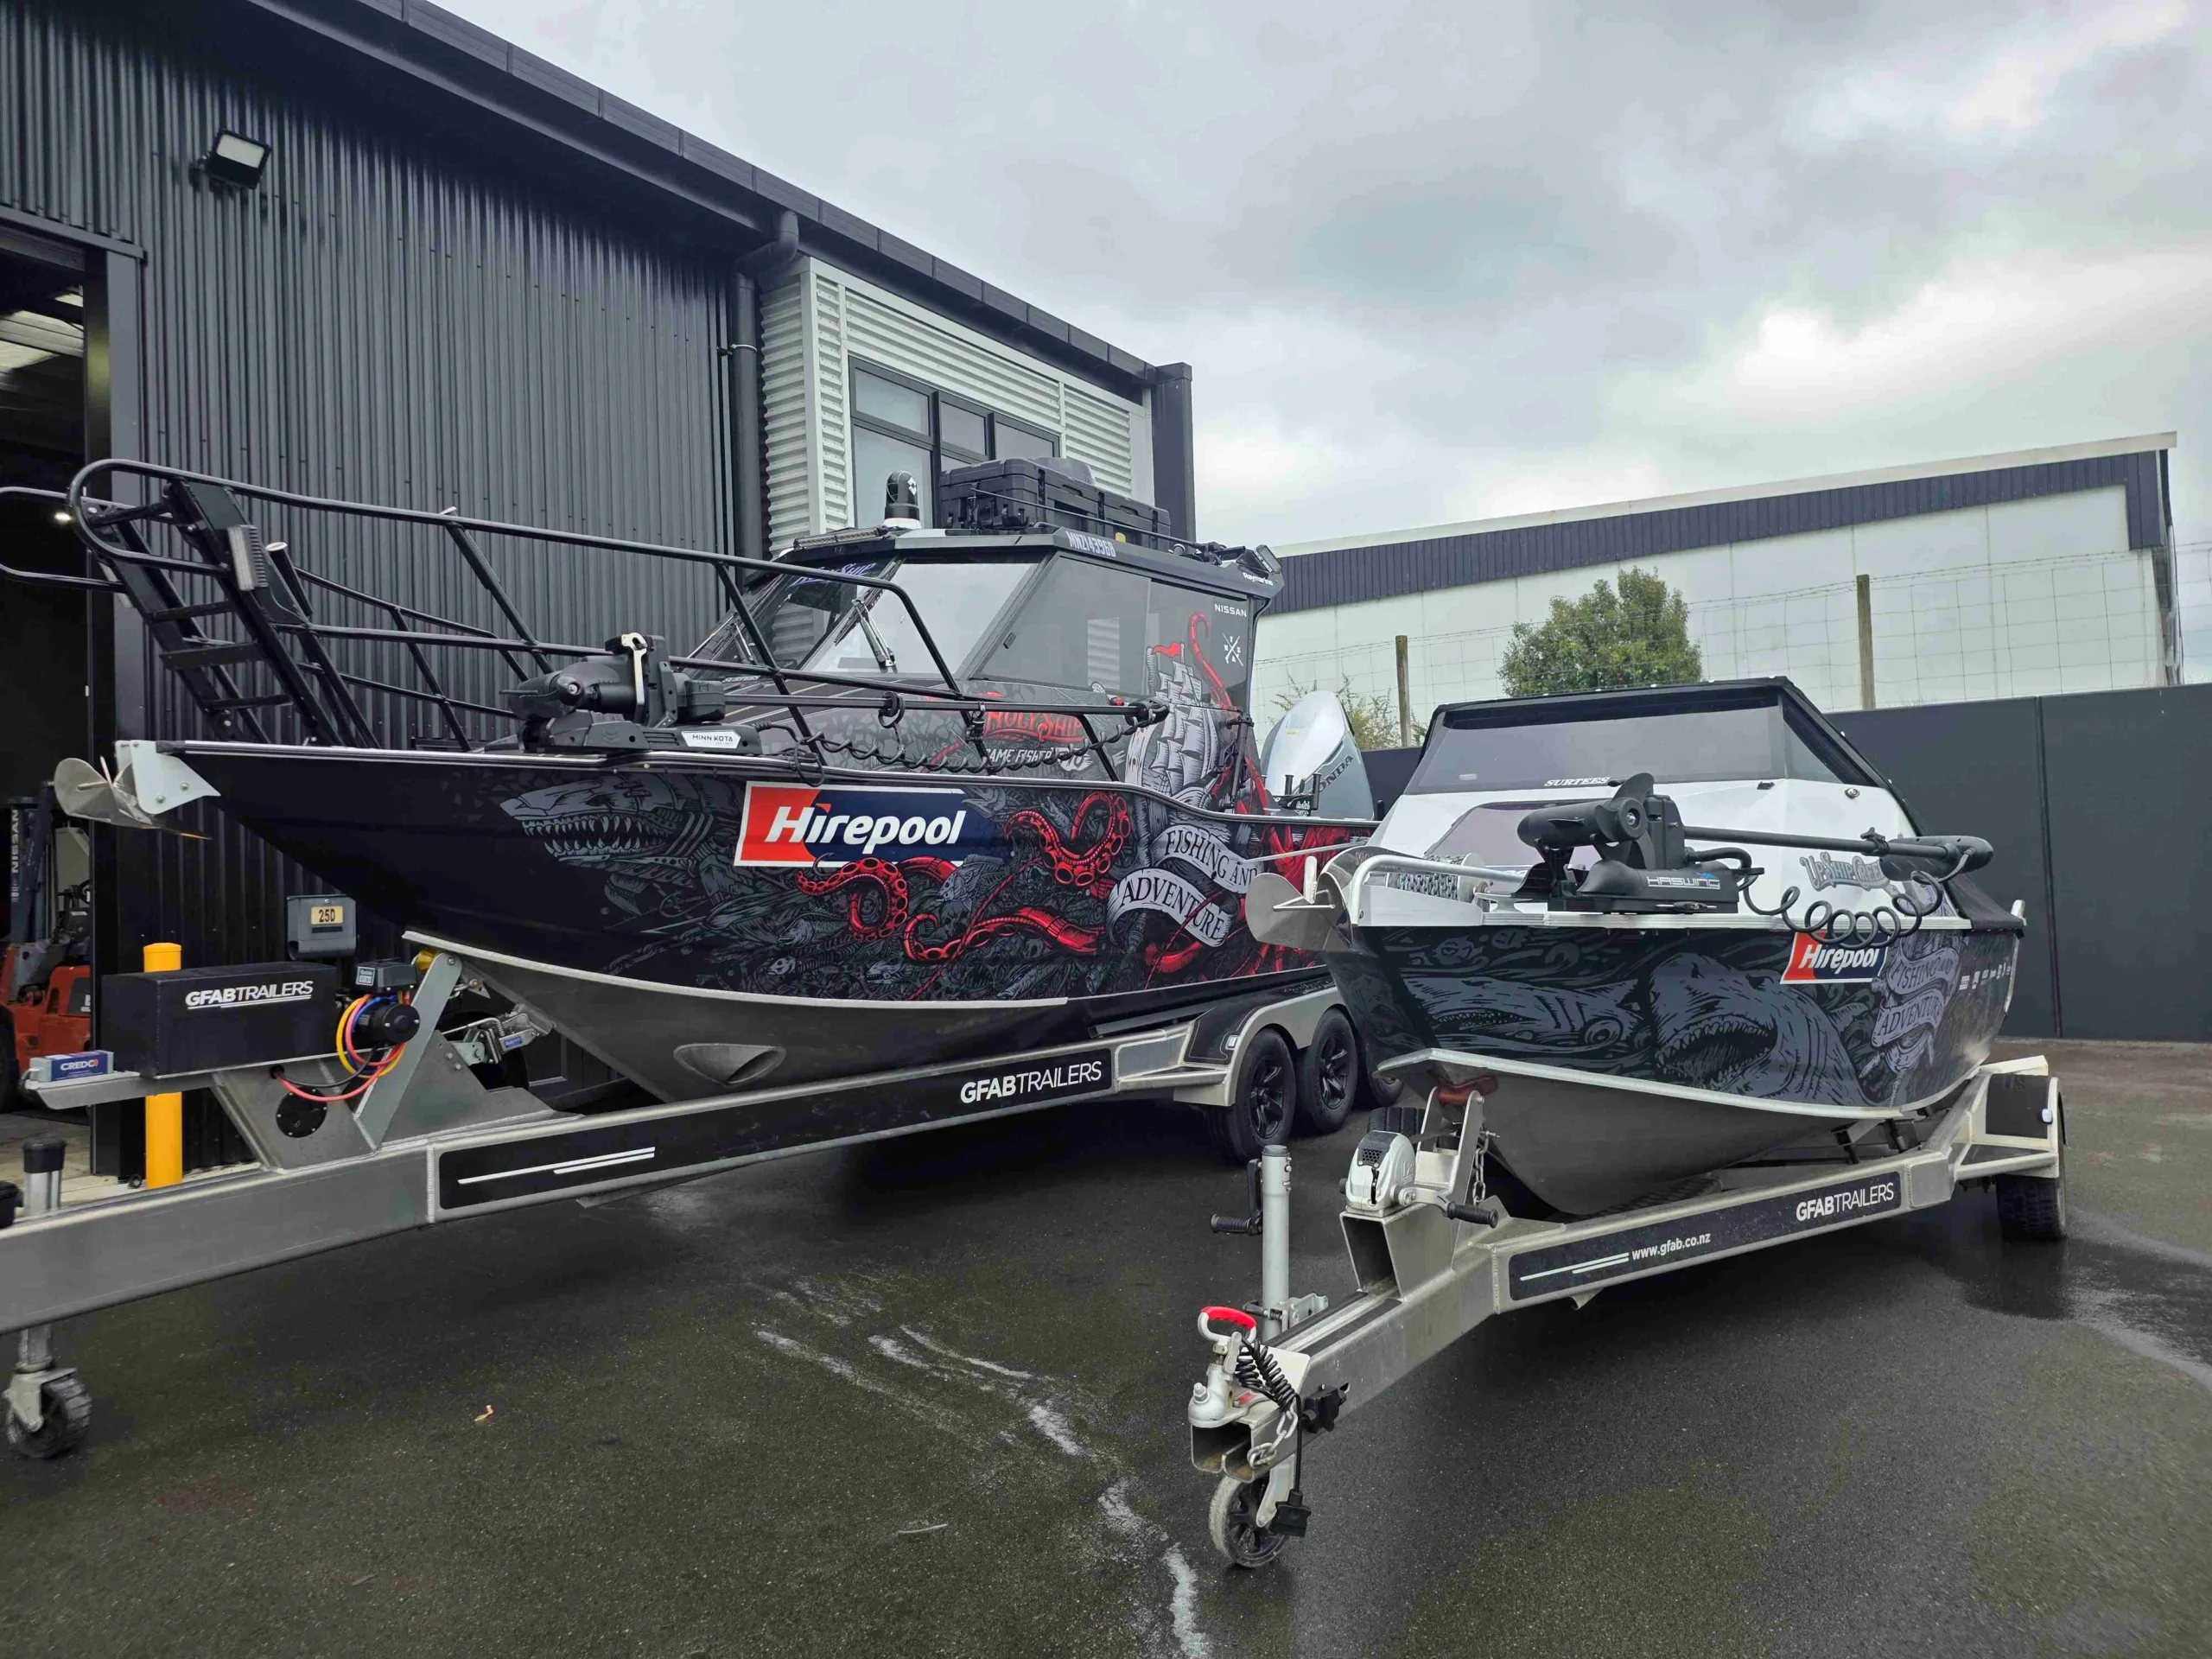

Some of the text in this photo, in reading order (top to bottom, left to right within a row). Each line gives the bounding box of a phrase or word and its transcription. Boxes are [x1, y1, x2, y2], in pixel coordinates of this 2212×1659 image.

[1214, 603, 1247, 617] NISSAN
[1544, 778, 1610, 786] SURTEES
[764, 803, 967, 855] Hirepool
[1164, 830, 1230, 879] FISHING
[1647, 875, 1720, 889] HASWING
[1118, 876, 1224, 941] ADVENTURE
[1798, 944, 1878, 975] Hirepool
[1631, 1233, 1711, 1261] www.gfab.co.nz
